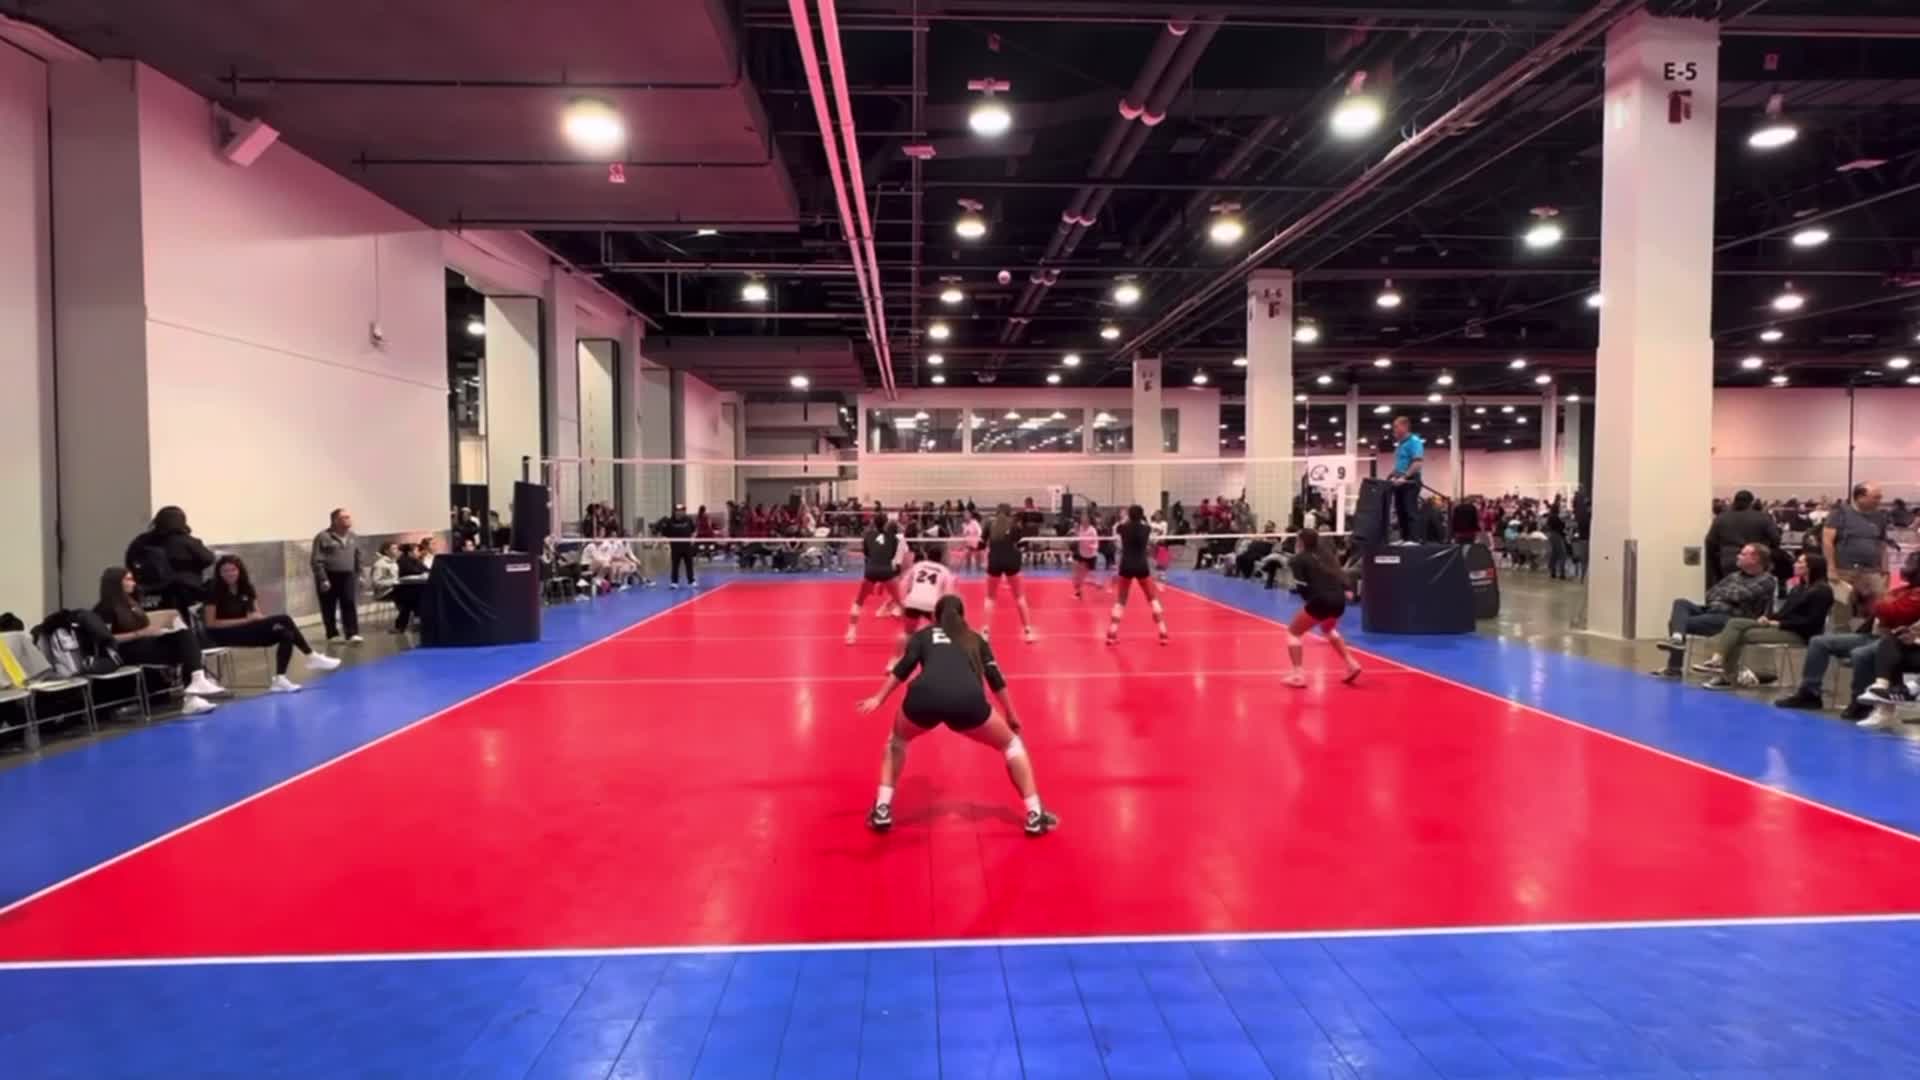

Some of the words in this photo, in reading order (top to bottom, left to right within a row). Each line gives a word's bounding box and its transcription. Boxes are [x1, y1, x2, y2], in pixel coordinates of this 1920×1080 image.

[1663, 62, 1698, 81] E-5
[1336, 465, 1347, 480] 9
[916, 569, 938, 585] 24
